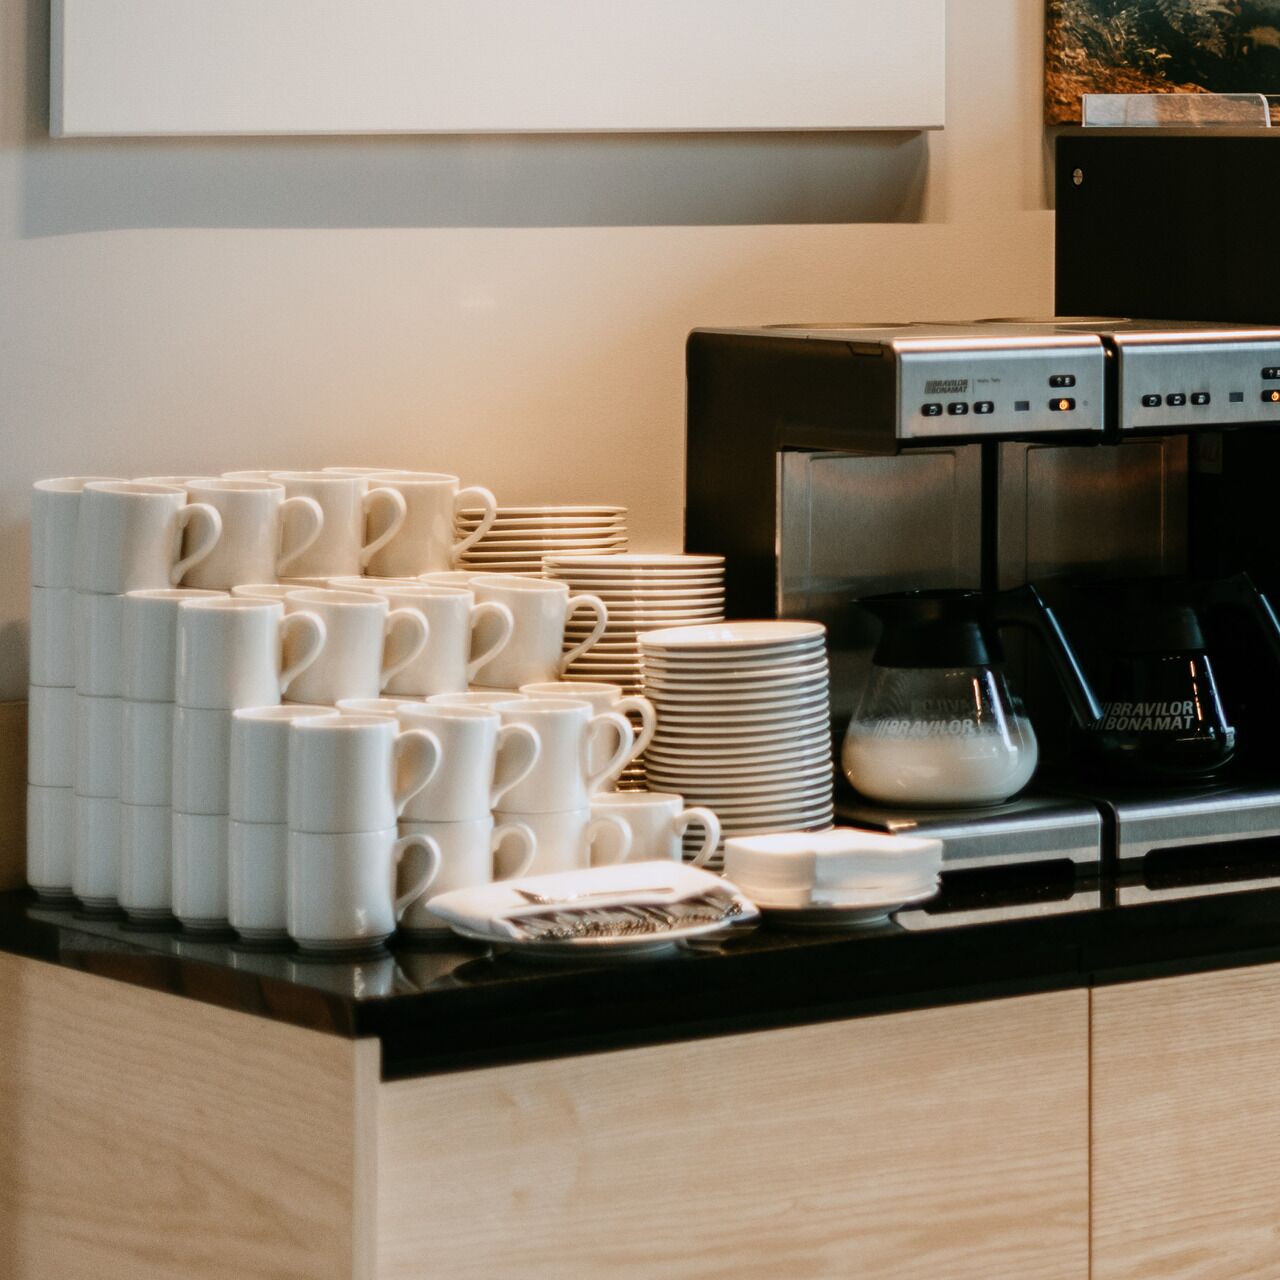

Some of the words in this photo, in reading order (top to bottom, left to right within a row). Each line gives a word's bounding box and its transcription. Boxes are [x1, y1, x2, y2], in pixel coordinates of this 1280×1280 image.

[1109, 700, 1195, 716] BRAVILOR
[886, 718, 974, 734] BRAVILOR
[1104, 715, 1195, 730] BONAMAT
